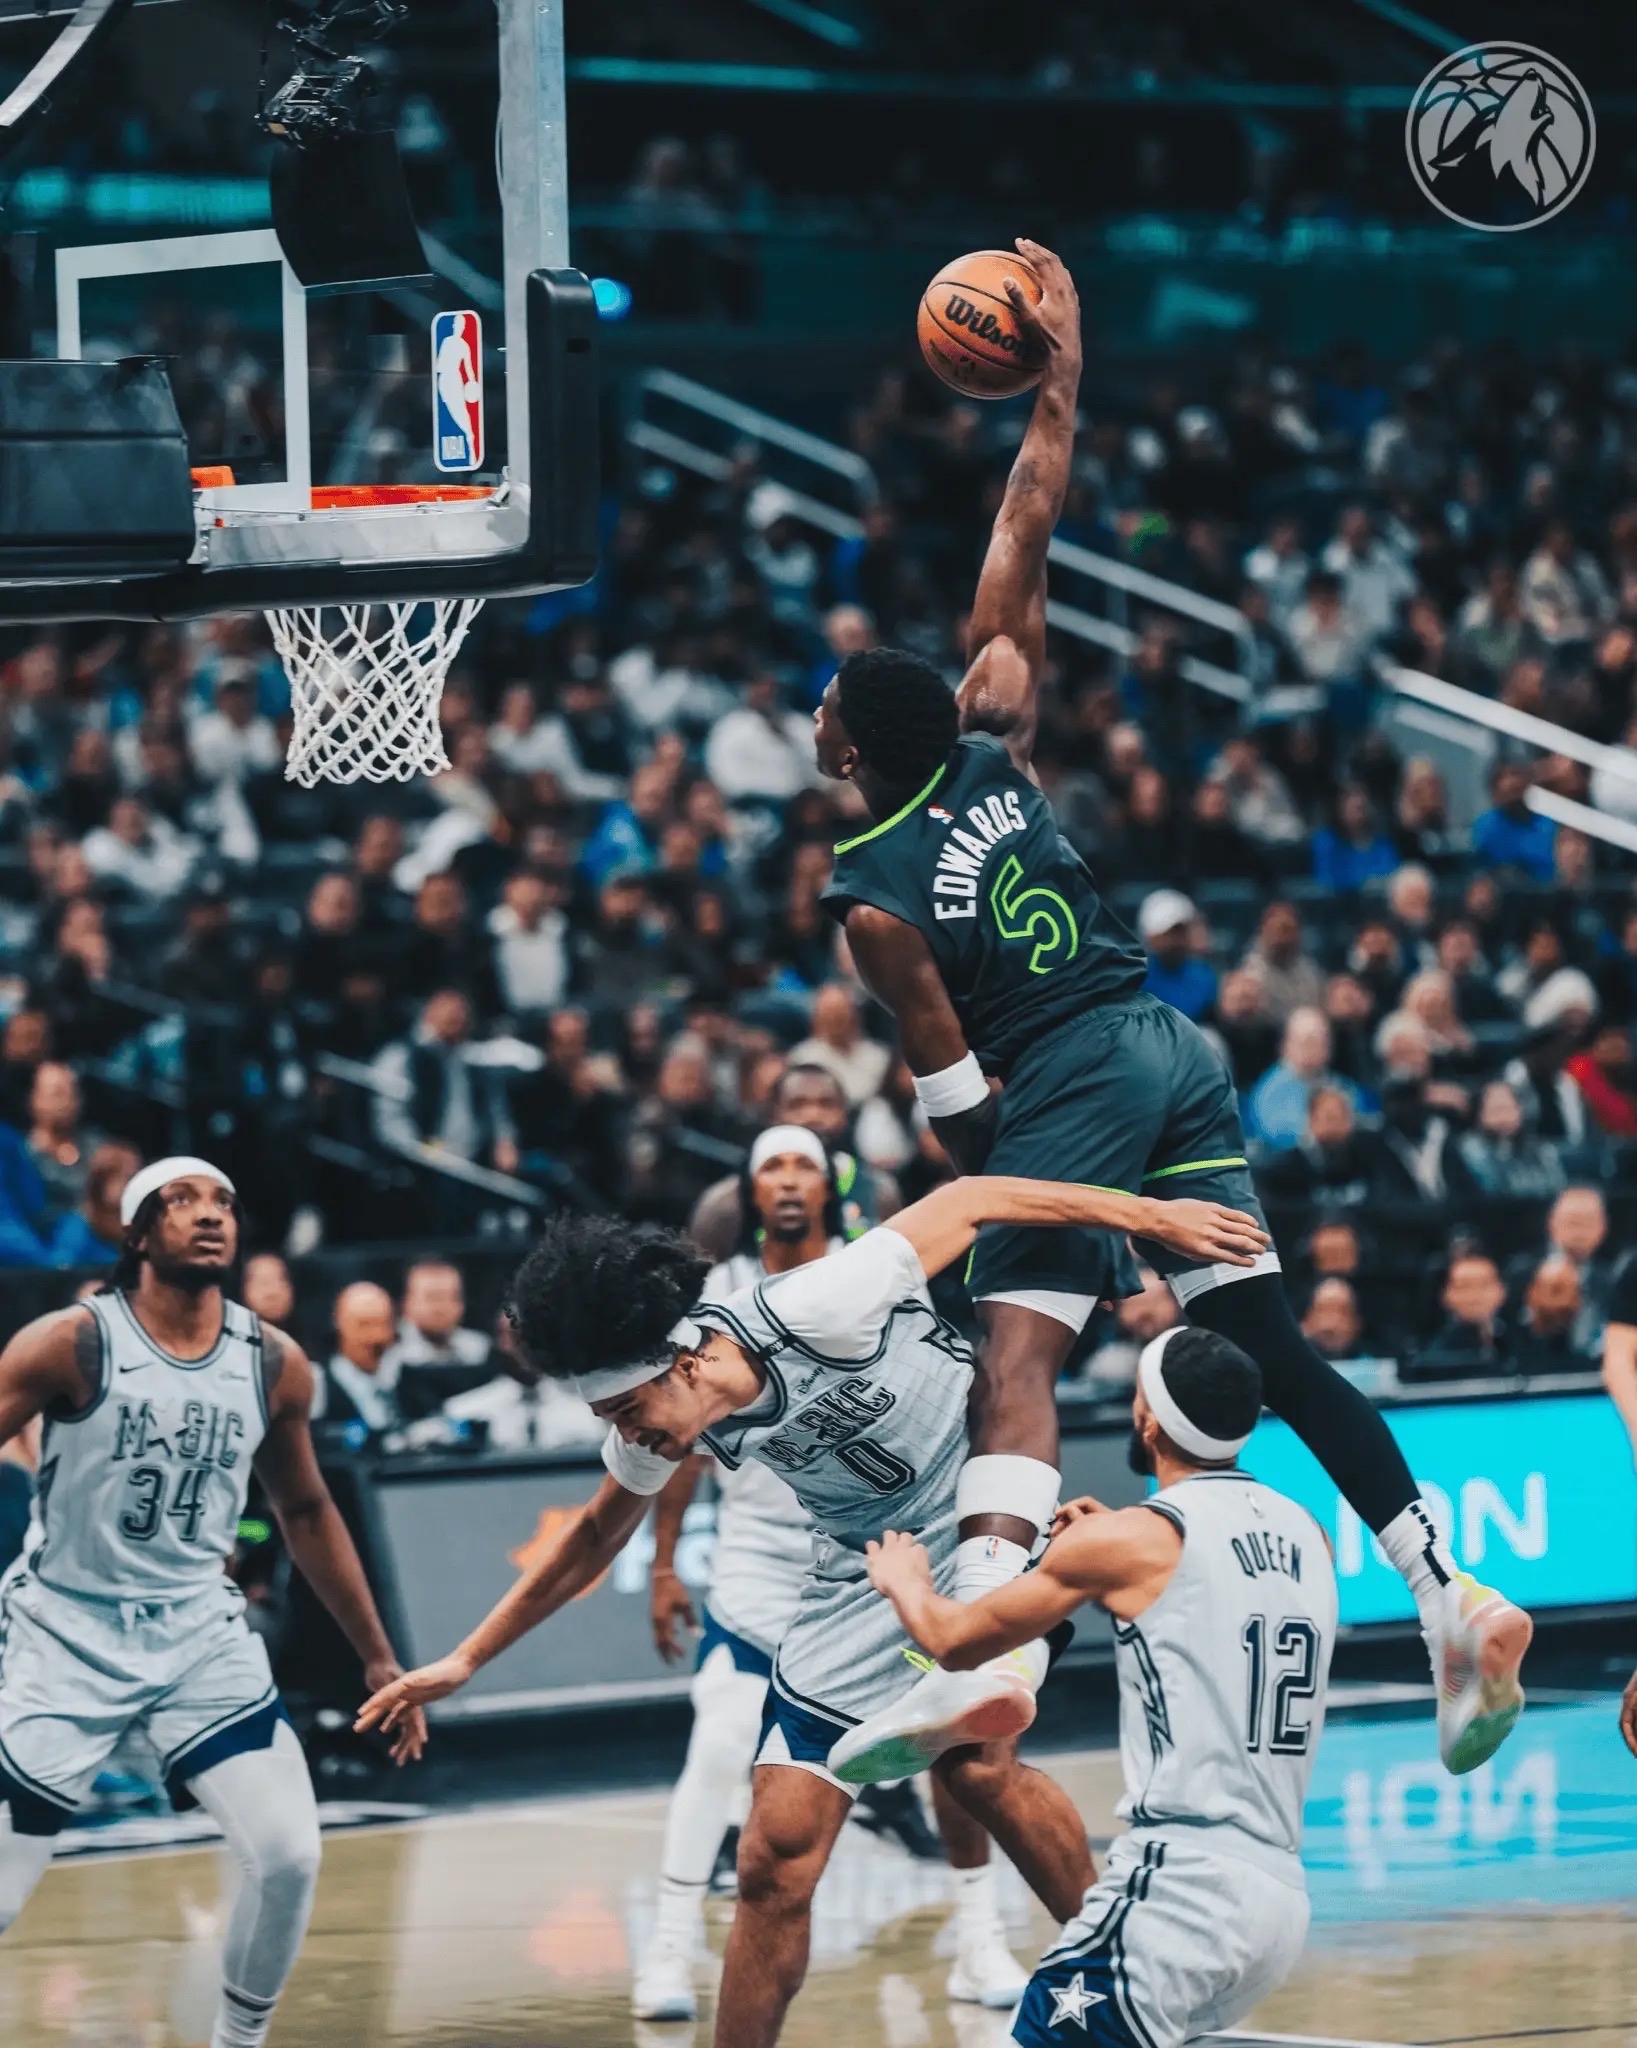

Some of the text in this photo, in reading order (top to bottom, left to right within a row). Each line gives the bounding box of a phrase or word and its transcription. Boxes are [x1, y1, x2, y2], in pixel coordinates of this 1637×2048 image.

[944, 294, 1025, 352] Wilso
[933, 791, 1028, 920] EDWARDS
[990, 854, 1079, 975] 5
[117, 1464, 214, 1542] 34
[830, 1437, 917, 1496] 0
[1231, 1530, 1302, 1584] QUEEN
[1242, 1613, 1321, 1756] 12
